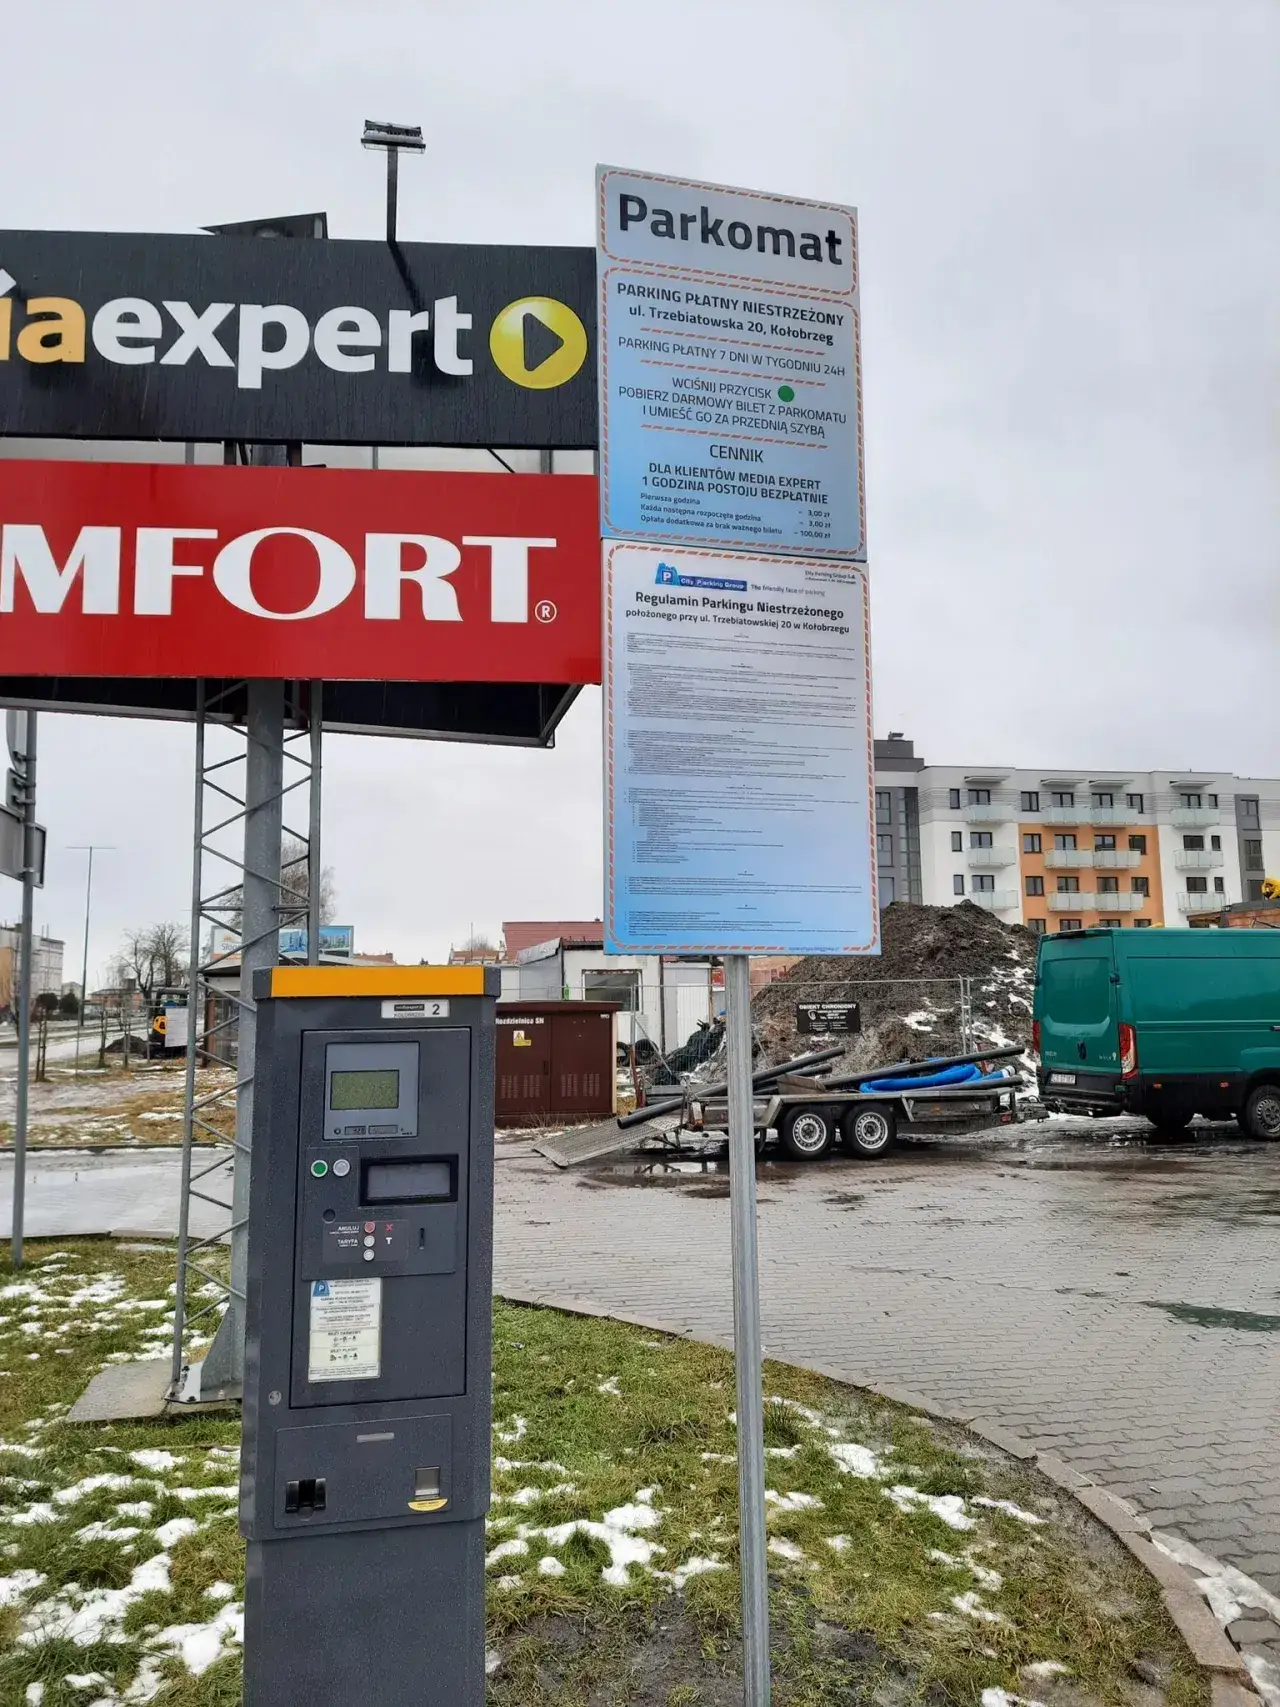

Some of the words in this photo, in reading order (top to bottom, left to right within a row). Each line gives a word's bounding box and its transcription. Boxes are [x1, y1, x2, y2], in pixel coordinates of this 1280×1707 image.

[619, 193, 842, 265] Parkomat
[617, 282, 681, 303] PARKING
[685, 292, 739, 311] PŁATNY
[743, 300, 844, 326] NIESTRZEŻONY
[629, 305, 645, 317] ul.
[649, 306, 744, 331] Trzebiatowska
[747, 320, 766, 336] 20,
[771, 324, 834, 347] Kołobrzeg
[618, 336, 670, 354] PARKING
[673, 343, 717, 359] PŁATNY
[720, 350, 726, 360] 7
[729, 351, 749, 364] DNI
[751, 355, 763, 365] W
[766, 356, 821, 374] TYGODNIU
[824, 364, 845, 376] 24H
[672, 376, 716, 394] WCIŚNIJ
[719, 382, 772, 400] PRZYCISK
[618, 386, 669, 402] POBIERZ
[672, 392, 733, 411] DARMOWY
[736, 400, 766, 414] BILET
[768, 404, 776, 415] Z
[778, 405, 847, 424] PARKOMATU
[649, 405, 693, 421] UMIEŚĆ
[696, 411, 712, 423] GO
[714, 413, 729, 425] ZA
[732, 415, 788, 434] PRZEDNIĄ
[790, 422, 825, 439] SZYBĄ
[709, 444, 764, 463] CENNIK
[649, 462, 672, 474] DLA
[675, 465, 736, 481] KLIENTÓW
[739, 472, 776, 486] MEDIA
[779, 476, 821, 490] EXPERT
[640, 492, 672, 502] Pierwsza
[673, 495, 701, 505] godzina
[642, 476, 648, 486] 1
[652, 476, 705, 492] GODZINA
[707, 482, 758, 497] POSTOJU
[761, 488, 828, 505] BEZPŁATNIE
[640, 503, 662, 513] Każda
[663, 506, 695, 516] następna
[735, 513, 761, 522] godzina
[666, 516, 705, 527] dodatkowa
[715, 521, 731, 530] brak
[763, 526, 783, 535] biletu
[0, 524, 557, 623] MFORT
[696, 579, 724, 588] Parking
[635, 591, 699, 607] Regulamin
[702, 597, 754, 614] Parkingu
[757, 601, 844, 621] Niestrzeżonego
[625, 608, 678, 622] położonego
[679, 613, 698, 624] przy
[700, 614, 711, 622] ul.
[712, 614, 779, 630] Trzebiatowskiej
[781, 620, 792, 629] 20
[802, 621, 850, 635] Kołobrzegu
[432, 1003, 440, 1016] 2
